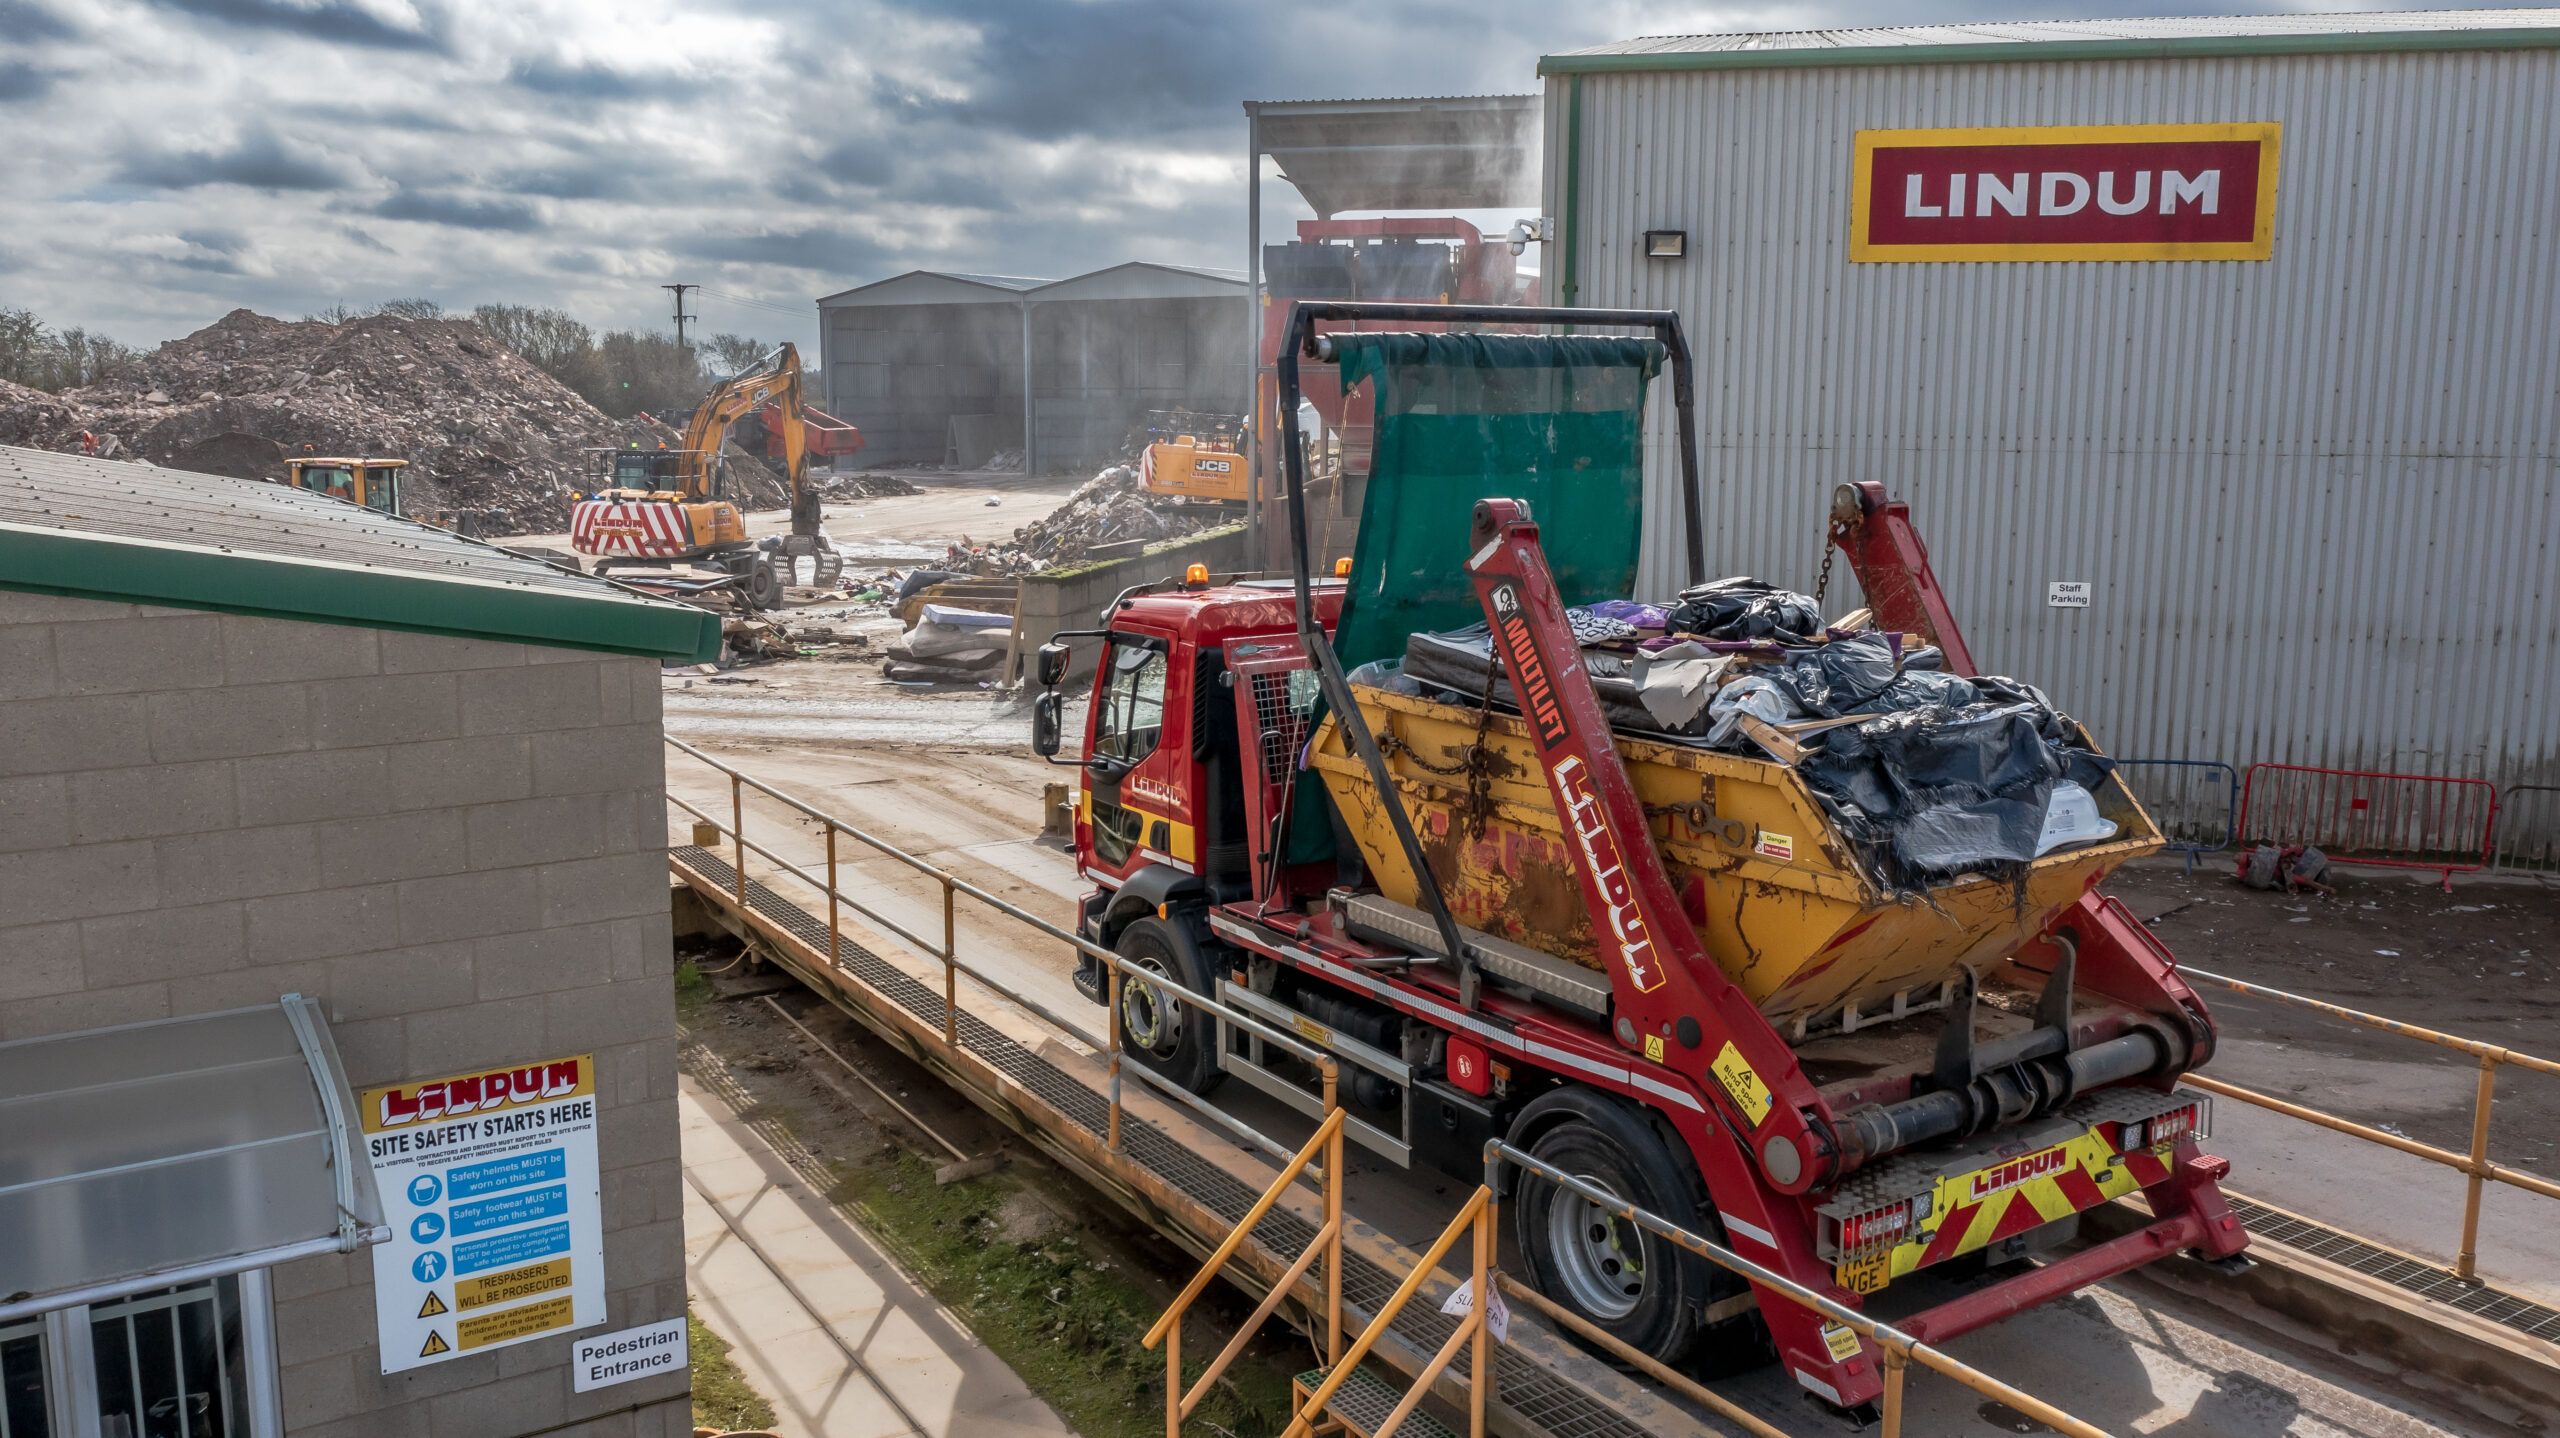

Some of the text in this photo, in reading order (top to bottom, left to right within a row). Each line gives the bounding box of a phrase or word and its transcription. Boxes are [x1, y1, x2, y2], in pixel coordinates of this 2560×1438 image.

[1904, 169, 2220, 217] LINDUM
[752, 387, 770, 404] JCB
[1195, 460, 1230, 472] JCB
[2051, 594, 2088, 605] Parking
[2059, 584, 2082, 592] Staff
[1504, 617, 1566, 741] MULTILIFT
[1766, 835, 1787, 844] Danger
[1723, 1064, 1742, 1087] Blind
[1740, 1087, 1757, 1108] spot
[1723, 1075, 1749, 1110] Take care
[371, 1101, 592, 1157] SITE SAFETY STARTS HERE
[416, 1149, 459, 1161] CONTRACTORS
[473, 1141, 497, 1150] DRIVERS
[498, 1138, 514, 1146] MUST
[515, 1134, 537, 1142] REPORT
[572, 1124, 592, 1132] OFFICE
[427, 1157, 452, 1166] RECEIVE
[453, 1153, 474, 1161] SAFETY
[475, 1147, 507, 1157] INDUCTION
[534, 1138, 552, 1146] RULES
[451, 1154, 562, 1182] Safety helmets MUST be
[470, 1169, 546, 1191] worn on this site
[454, 1190, 562, 1219] Safety footwear MUST be
[474, 1206, 545, 1227] worn on this site
[455, 1224, 567, 1253] Personal protective equipment
[457, 1252, 479, 1262] MUST
[482, 1248, 491, 1256] be
[493, 1244, 511, 1254] used
[522, 1237, 549, 1248] comply
[550, 1233, 566, 1242] with
[474, 1259, 489, 1267] safe
[491, 1251, 522, 1264] systems
[533, 1245, 551, 1253] work
[478, 1265, 549, 1289] TRESPASSERS
[1848, 1267, 1879, 1292] VGE
[460, 1275, 568, 1308] WILL BE PROSECUTED
[459, 1299, 570, 1329] Parents are advised to warn
[464, 1324, 498, 1337] children
[499, 1320, 508, 1328] of
[509, 1317, 523, 1326] the
[525, 1311, 556, 1324] dangers
[483, 1320, 550, 1341] entering this site
[582, 1330, 679, 1363] Pedestrian
[591, 1352, 672, 1381] Entrance
